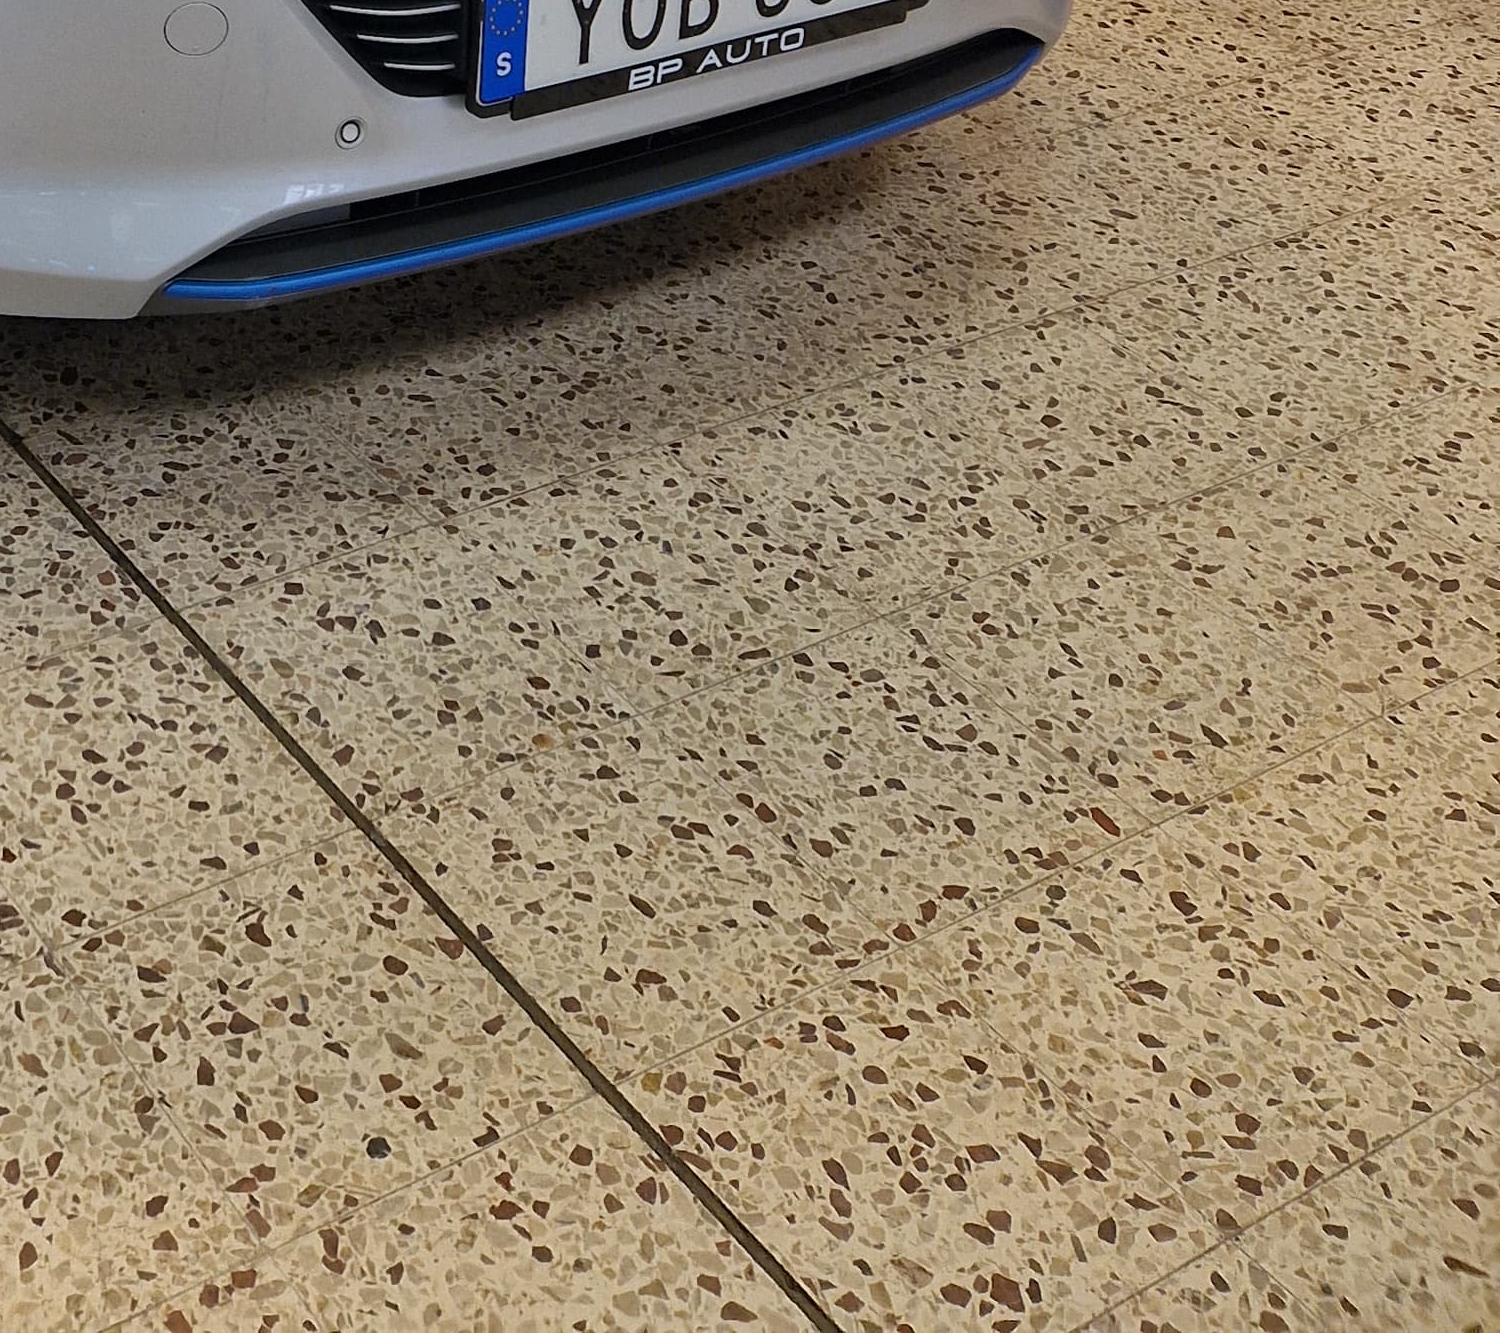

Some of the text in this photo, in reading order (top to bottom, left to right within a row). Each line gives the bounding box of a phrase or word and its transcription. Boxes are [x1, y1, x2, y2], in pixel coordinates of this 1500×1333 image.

[496, 51, 512, 77] S
[627, 27, 805, 92] BP AUTO
